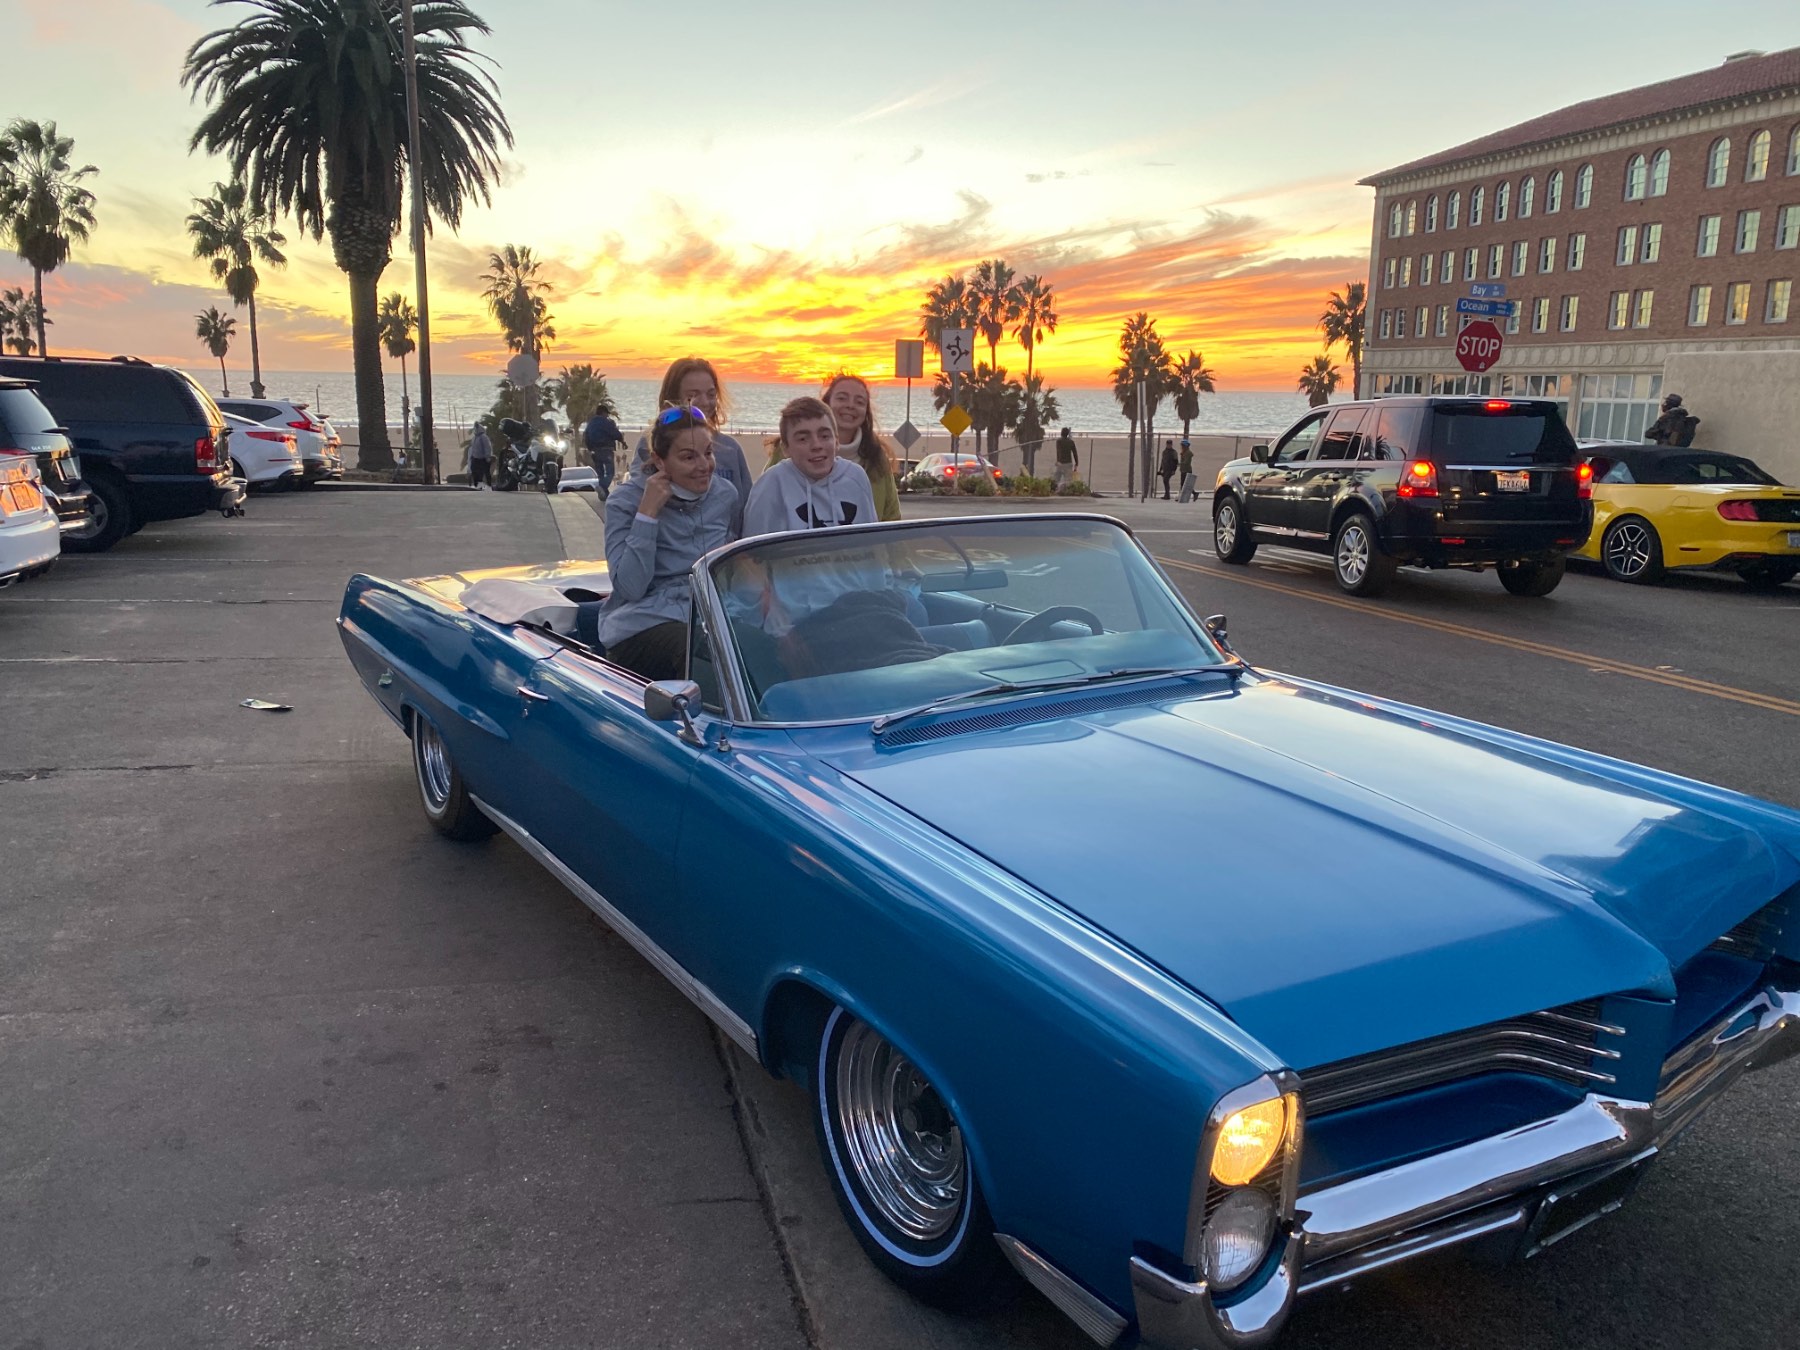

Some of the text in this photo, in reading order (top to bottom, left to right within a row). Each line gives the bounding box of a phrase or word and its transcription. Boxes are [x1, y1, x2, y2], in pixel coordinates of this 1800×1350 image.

[1472, 285, 1486, 297] Bay
[1460, 300, 1489, 311] Ocean
[1458, 336, 1500, 358] STOP
